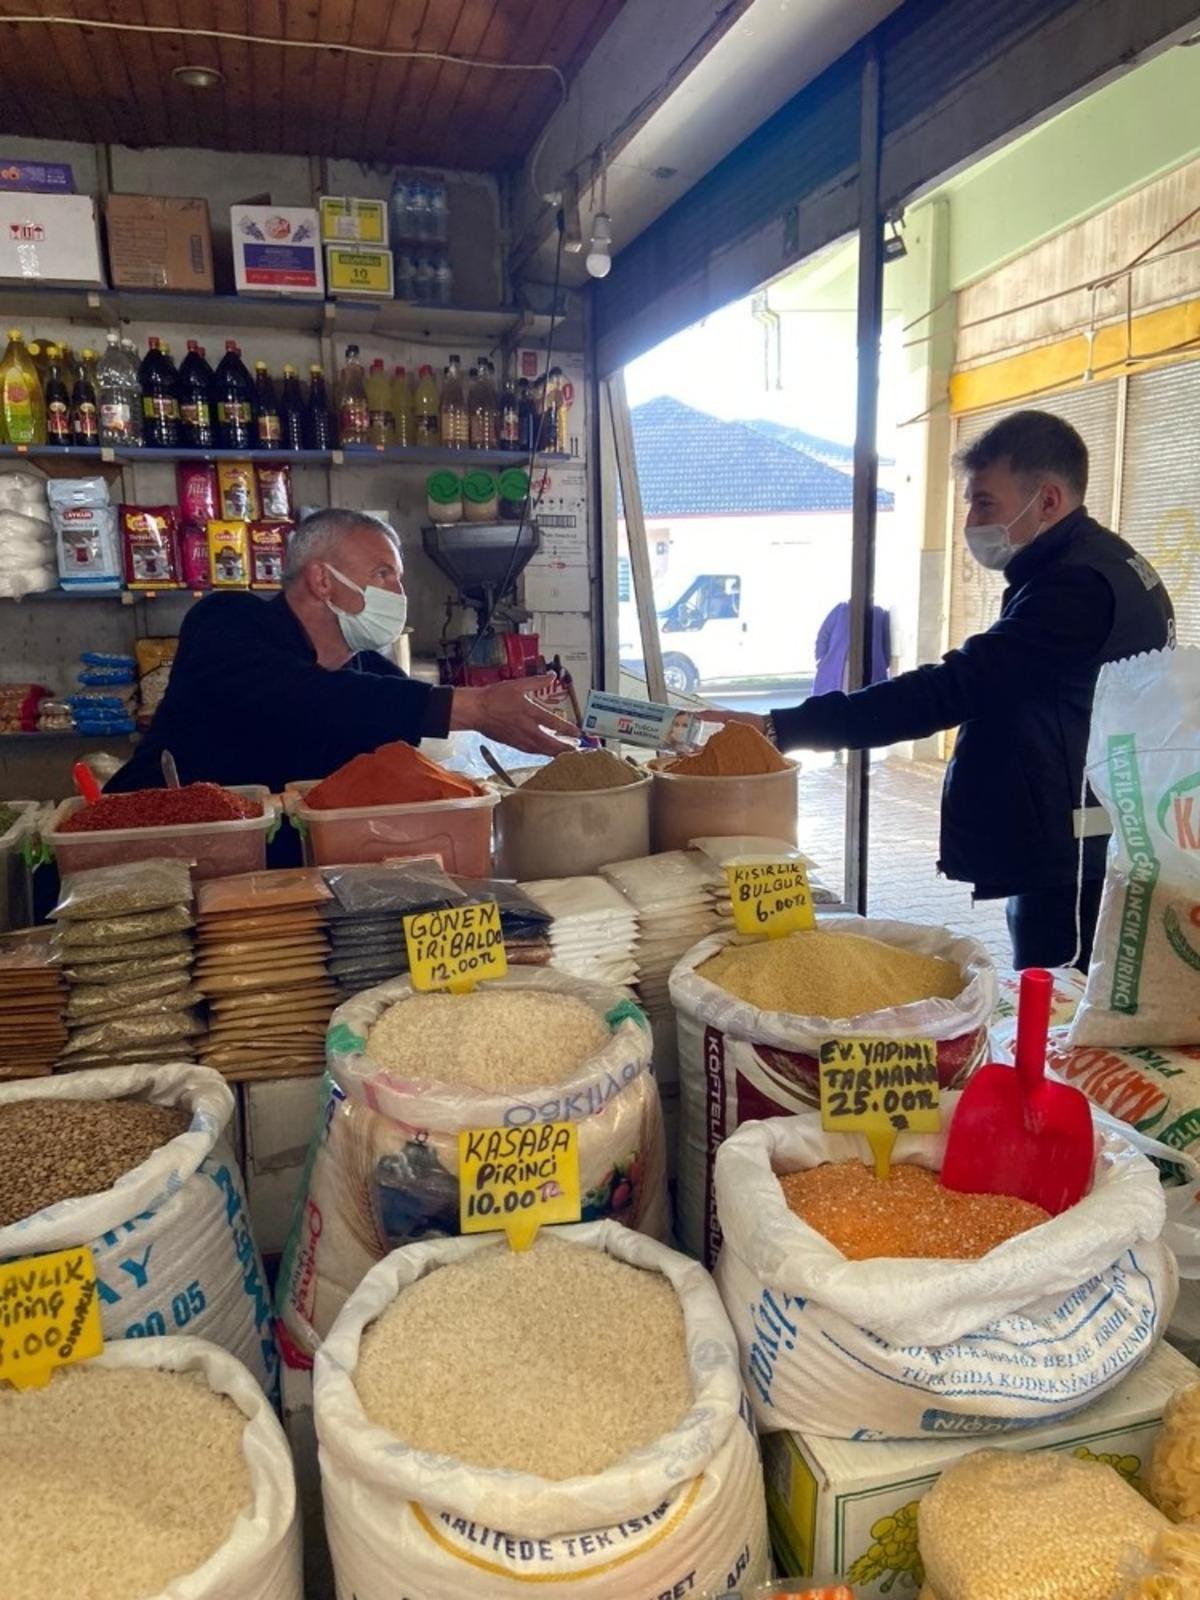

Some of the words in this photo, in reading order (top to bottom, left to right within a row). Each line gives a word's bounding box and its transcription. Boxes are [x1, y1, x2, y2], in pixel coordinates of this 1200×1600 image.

[735, 863, 800, 884] KISIRLIK
[739, 874, 805, 902] BULGUR
[410, 903, 496, 939] GÖNEN
[823, 1062, 938, 1091] TARHANA
[465, 1124, 570, 1163] KASABA
[171, 1280, 206, 1328] 05
[562, 1531, 614, 1558] TEK
